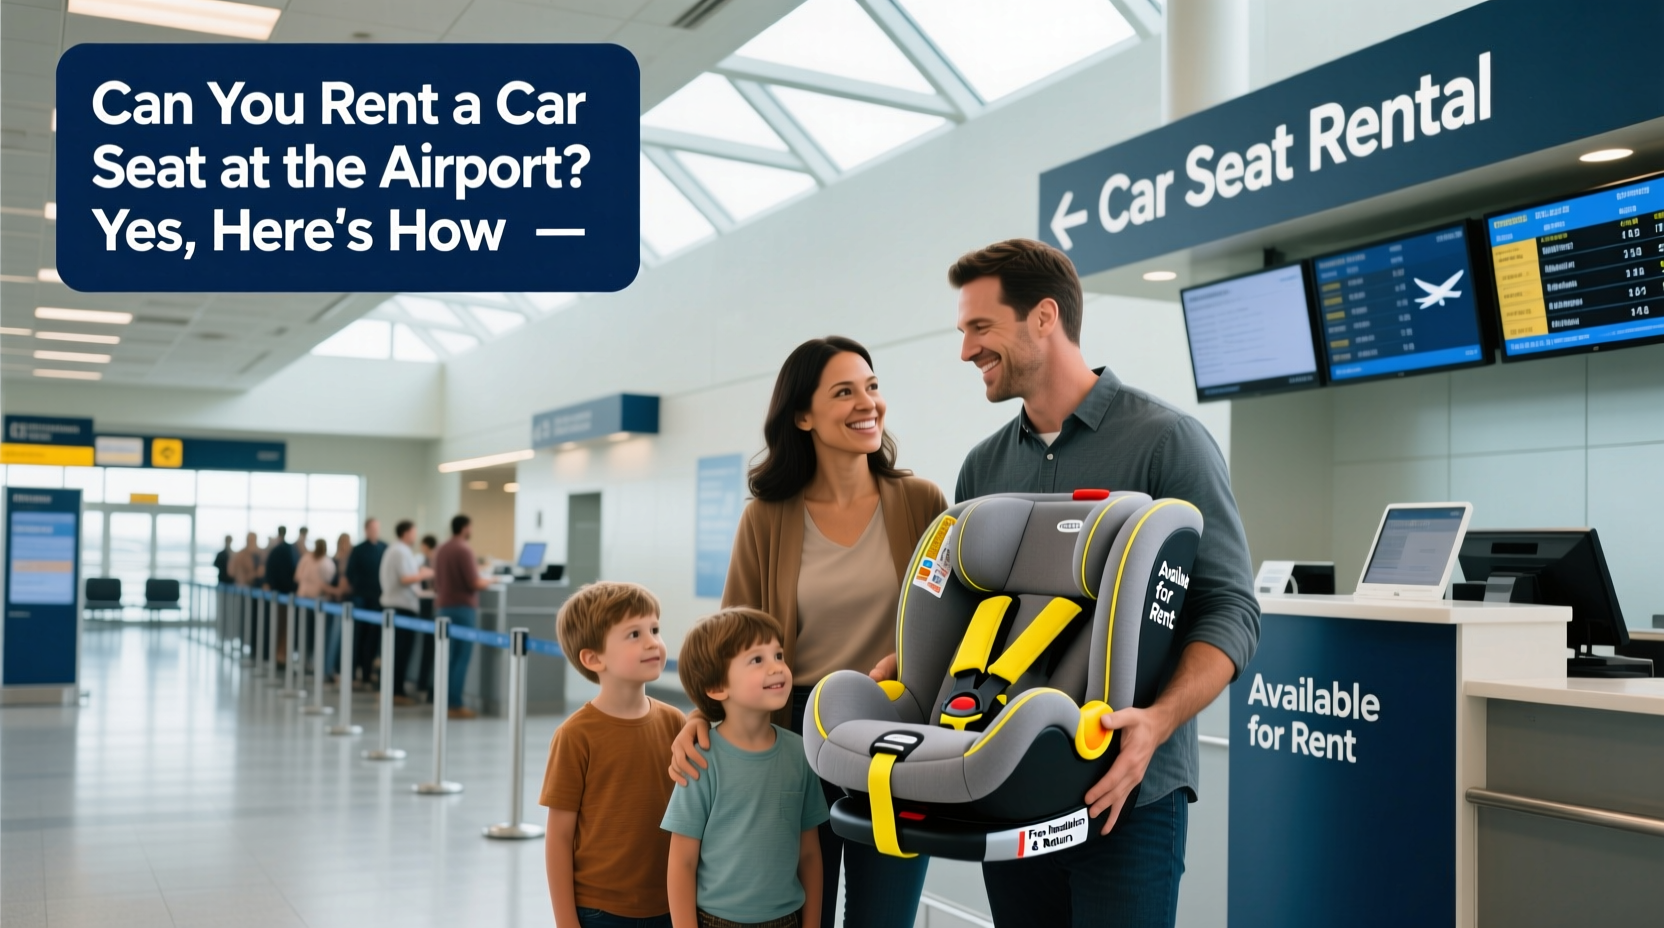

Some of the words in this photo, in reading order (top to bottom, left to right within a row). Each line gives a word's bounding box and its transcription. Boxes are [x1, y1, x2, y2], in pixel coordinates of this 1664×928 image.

[1098, 169, 1175, 234] Car
[1184, 123, 1295, 208] Seat
[1308, 50, 1492, 173] Rental
[1149, 601, 1176, 630] Rent
[1155, 580, 1174, 604] for
[1247, 673, 1380, 722] Available
[1247, 714, 1285, 750] for
[1291, 721, 1357, 763] Rent
